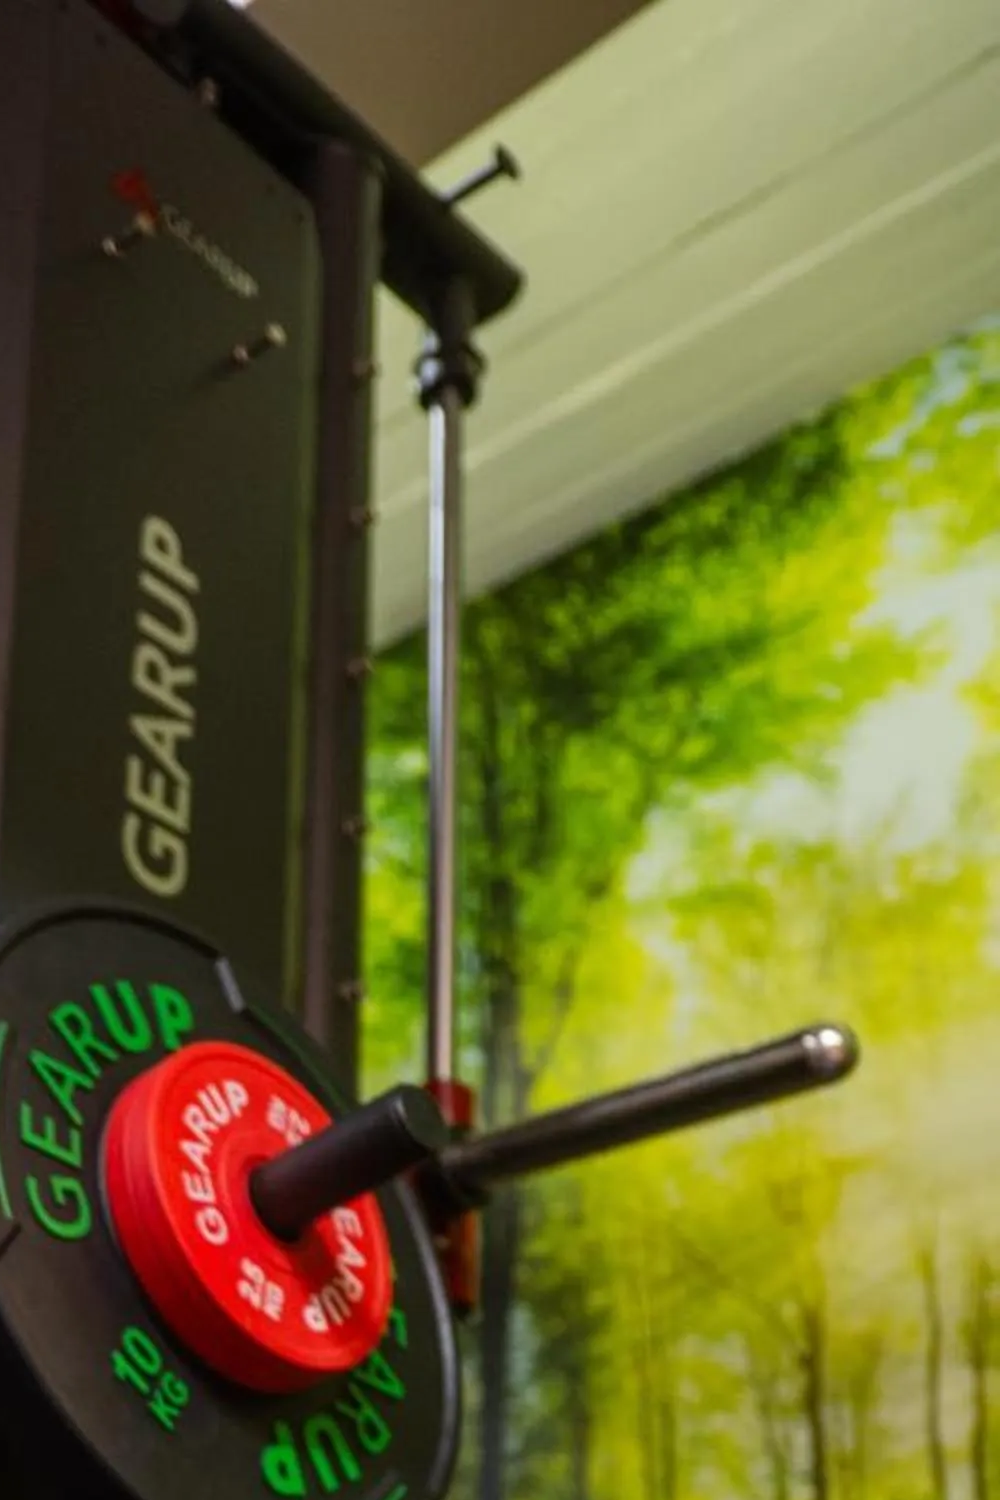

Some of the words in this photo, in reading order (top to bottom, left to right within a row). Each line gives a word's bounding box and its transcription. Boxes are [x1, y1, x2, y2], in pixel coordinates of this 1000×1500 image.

[121, 514, 200, 898] GEARUP
[20, 978, 195, 1240] GEARUP
[179, 1080, 249, 1246] GEARUP
[303, 1206, 367, 1334] EARUP
[111, 1326, 161, 1395] 10
[148, 1371, 189, 1431] KG
[261, 1307, 408, 1497] ARUP
